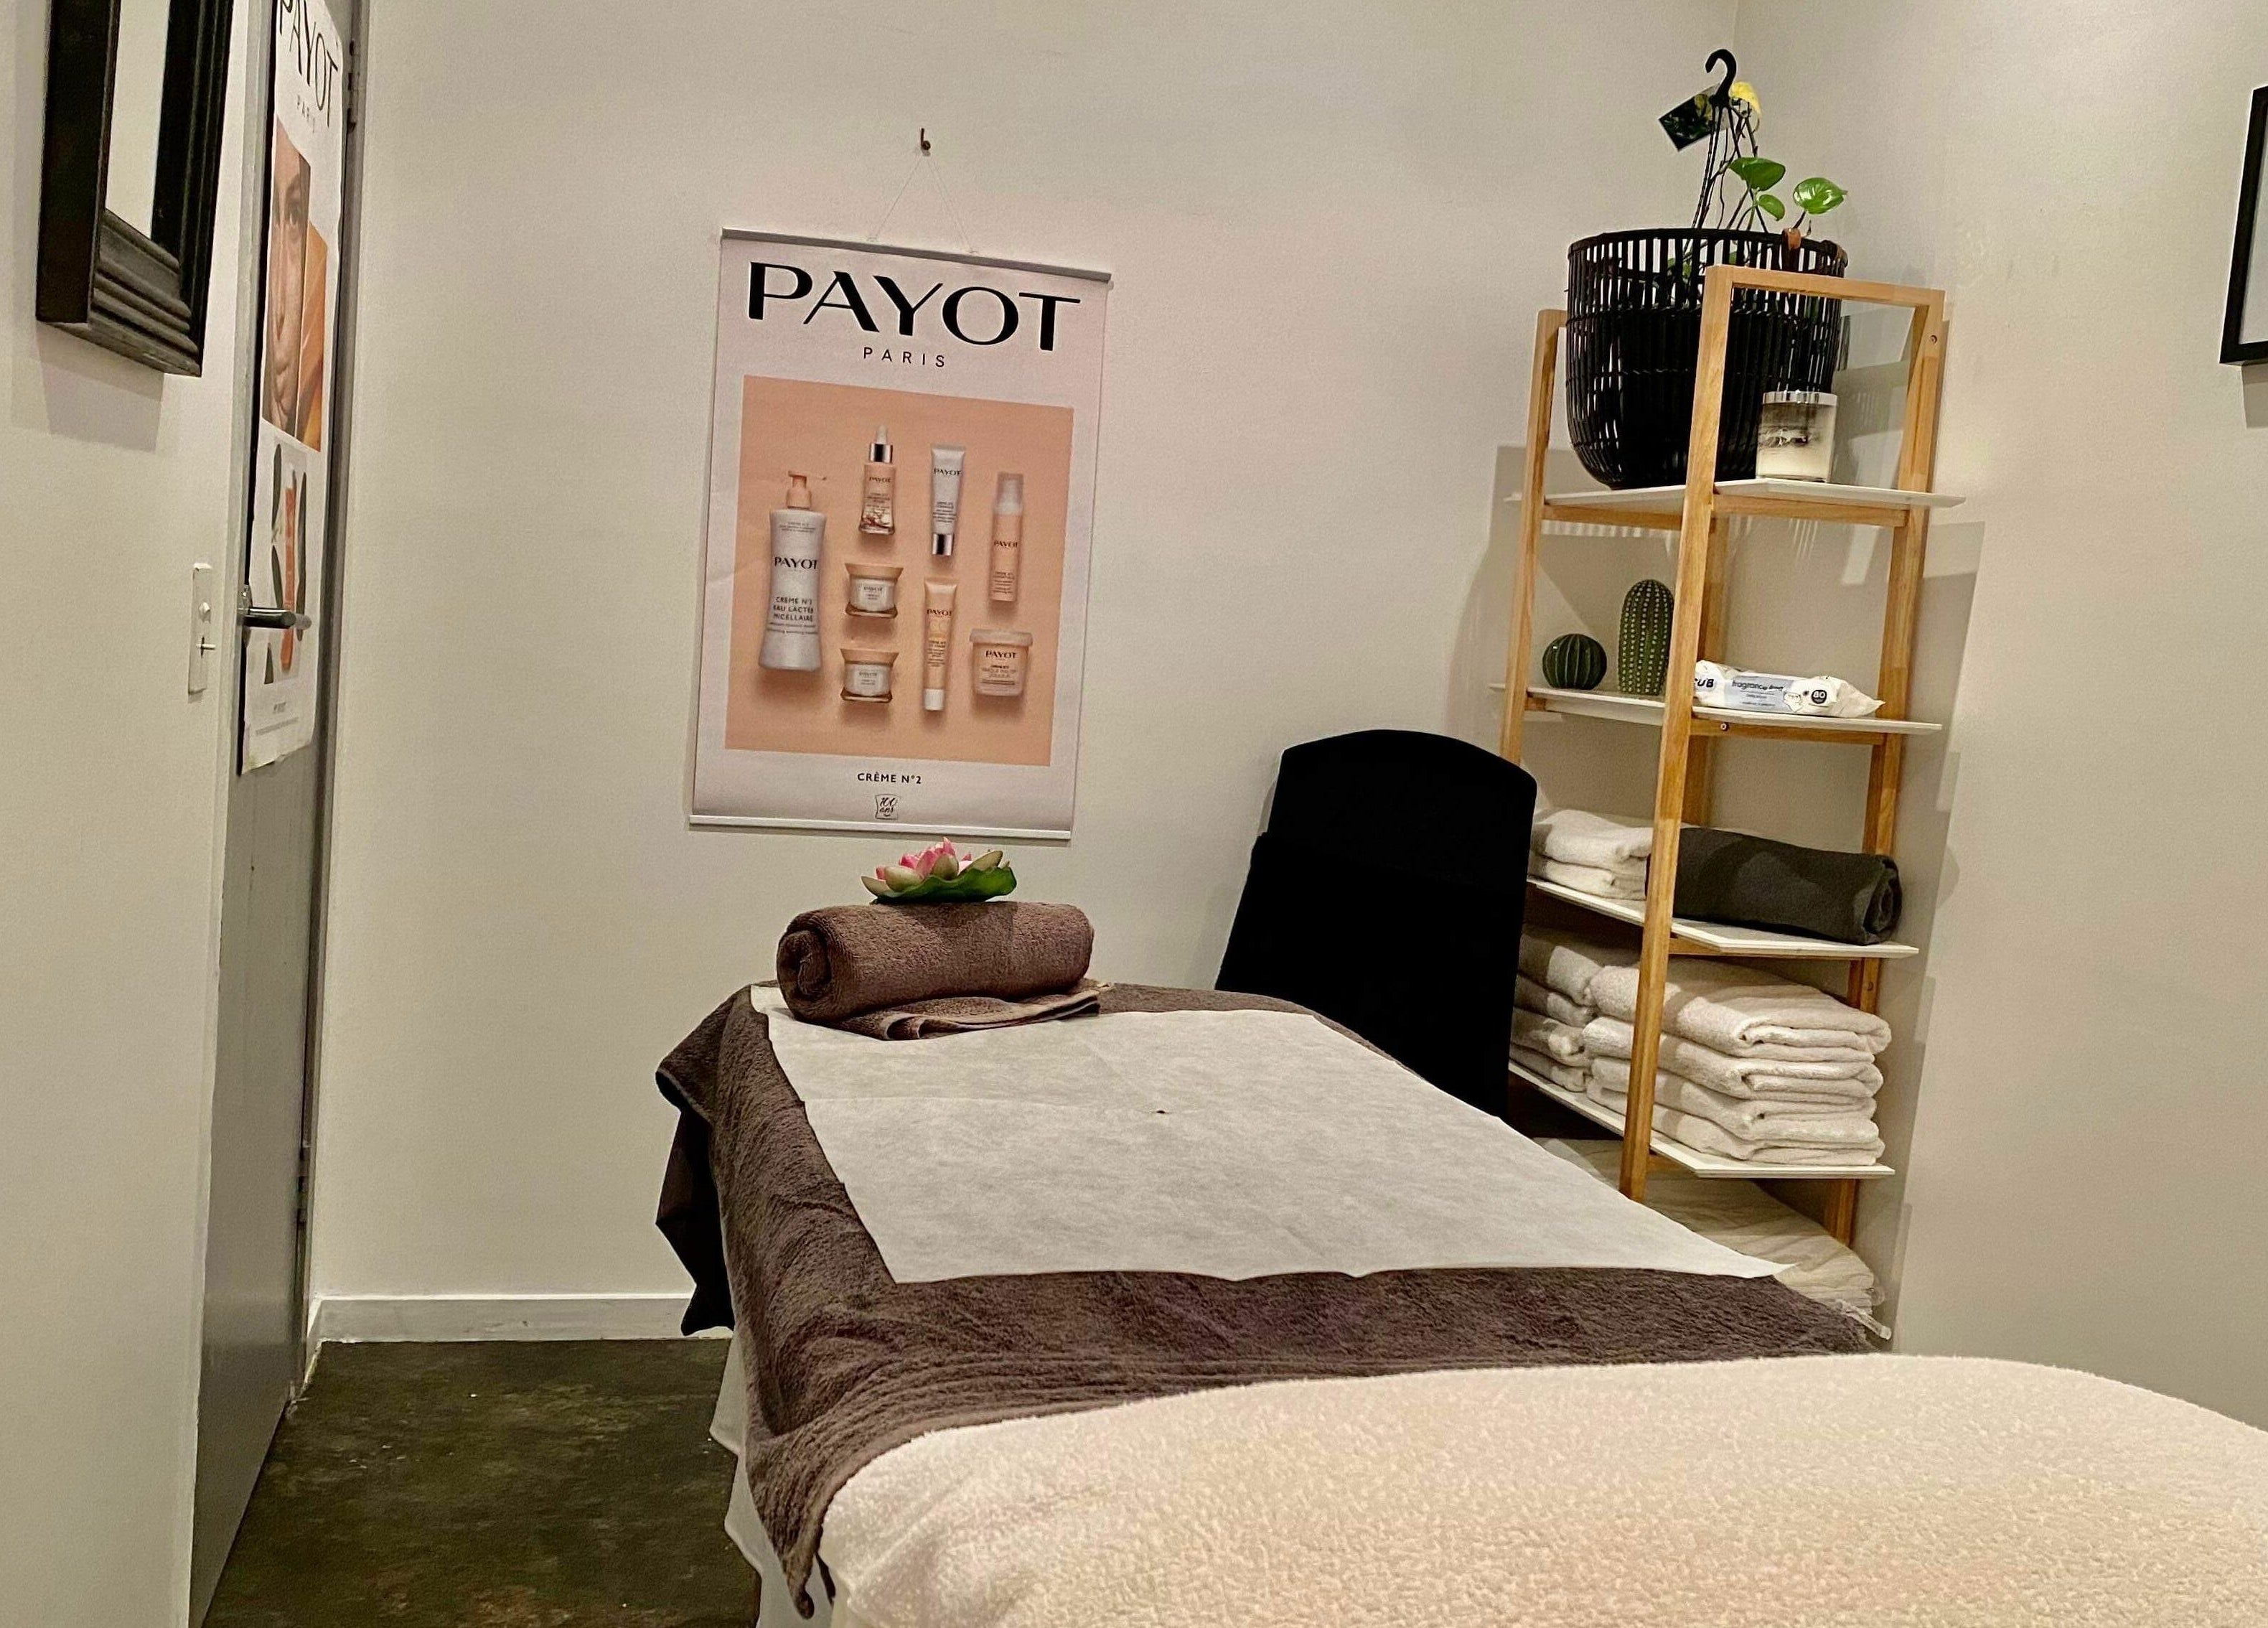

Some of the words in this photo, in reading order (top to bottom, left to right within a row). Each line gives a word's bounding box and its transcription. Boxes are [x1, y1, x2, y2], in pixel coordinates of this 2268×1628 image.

[749, 261, 1081, 352] PAYOT
[863, 347, 945, 368] PARIS
[934, 467, 962, 476] PAYOT
[774, 556, 817, 569] PAYOT
[927, 608, 952, 617] PAYOT
[985, 650, 1017, 659] PAYOT
[1694, 678, 1715, 688] UB
[857, 771, 896, 783] CRÈME
[901, 775, 922, 785] N°2
